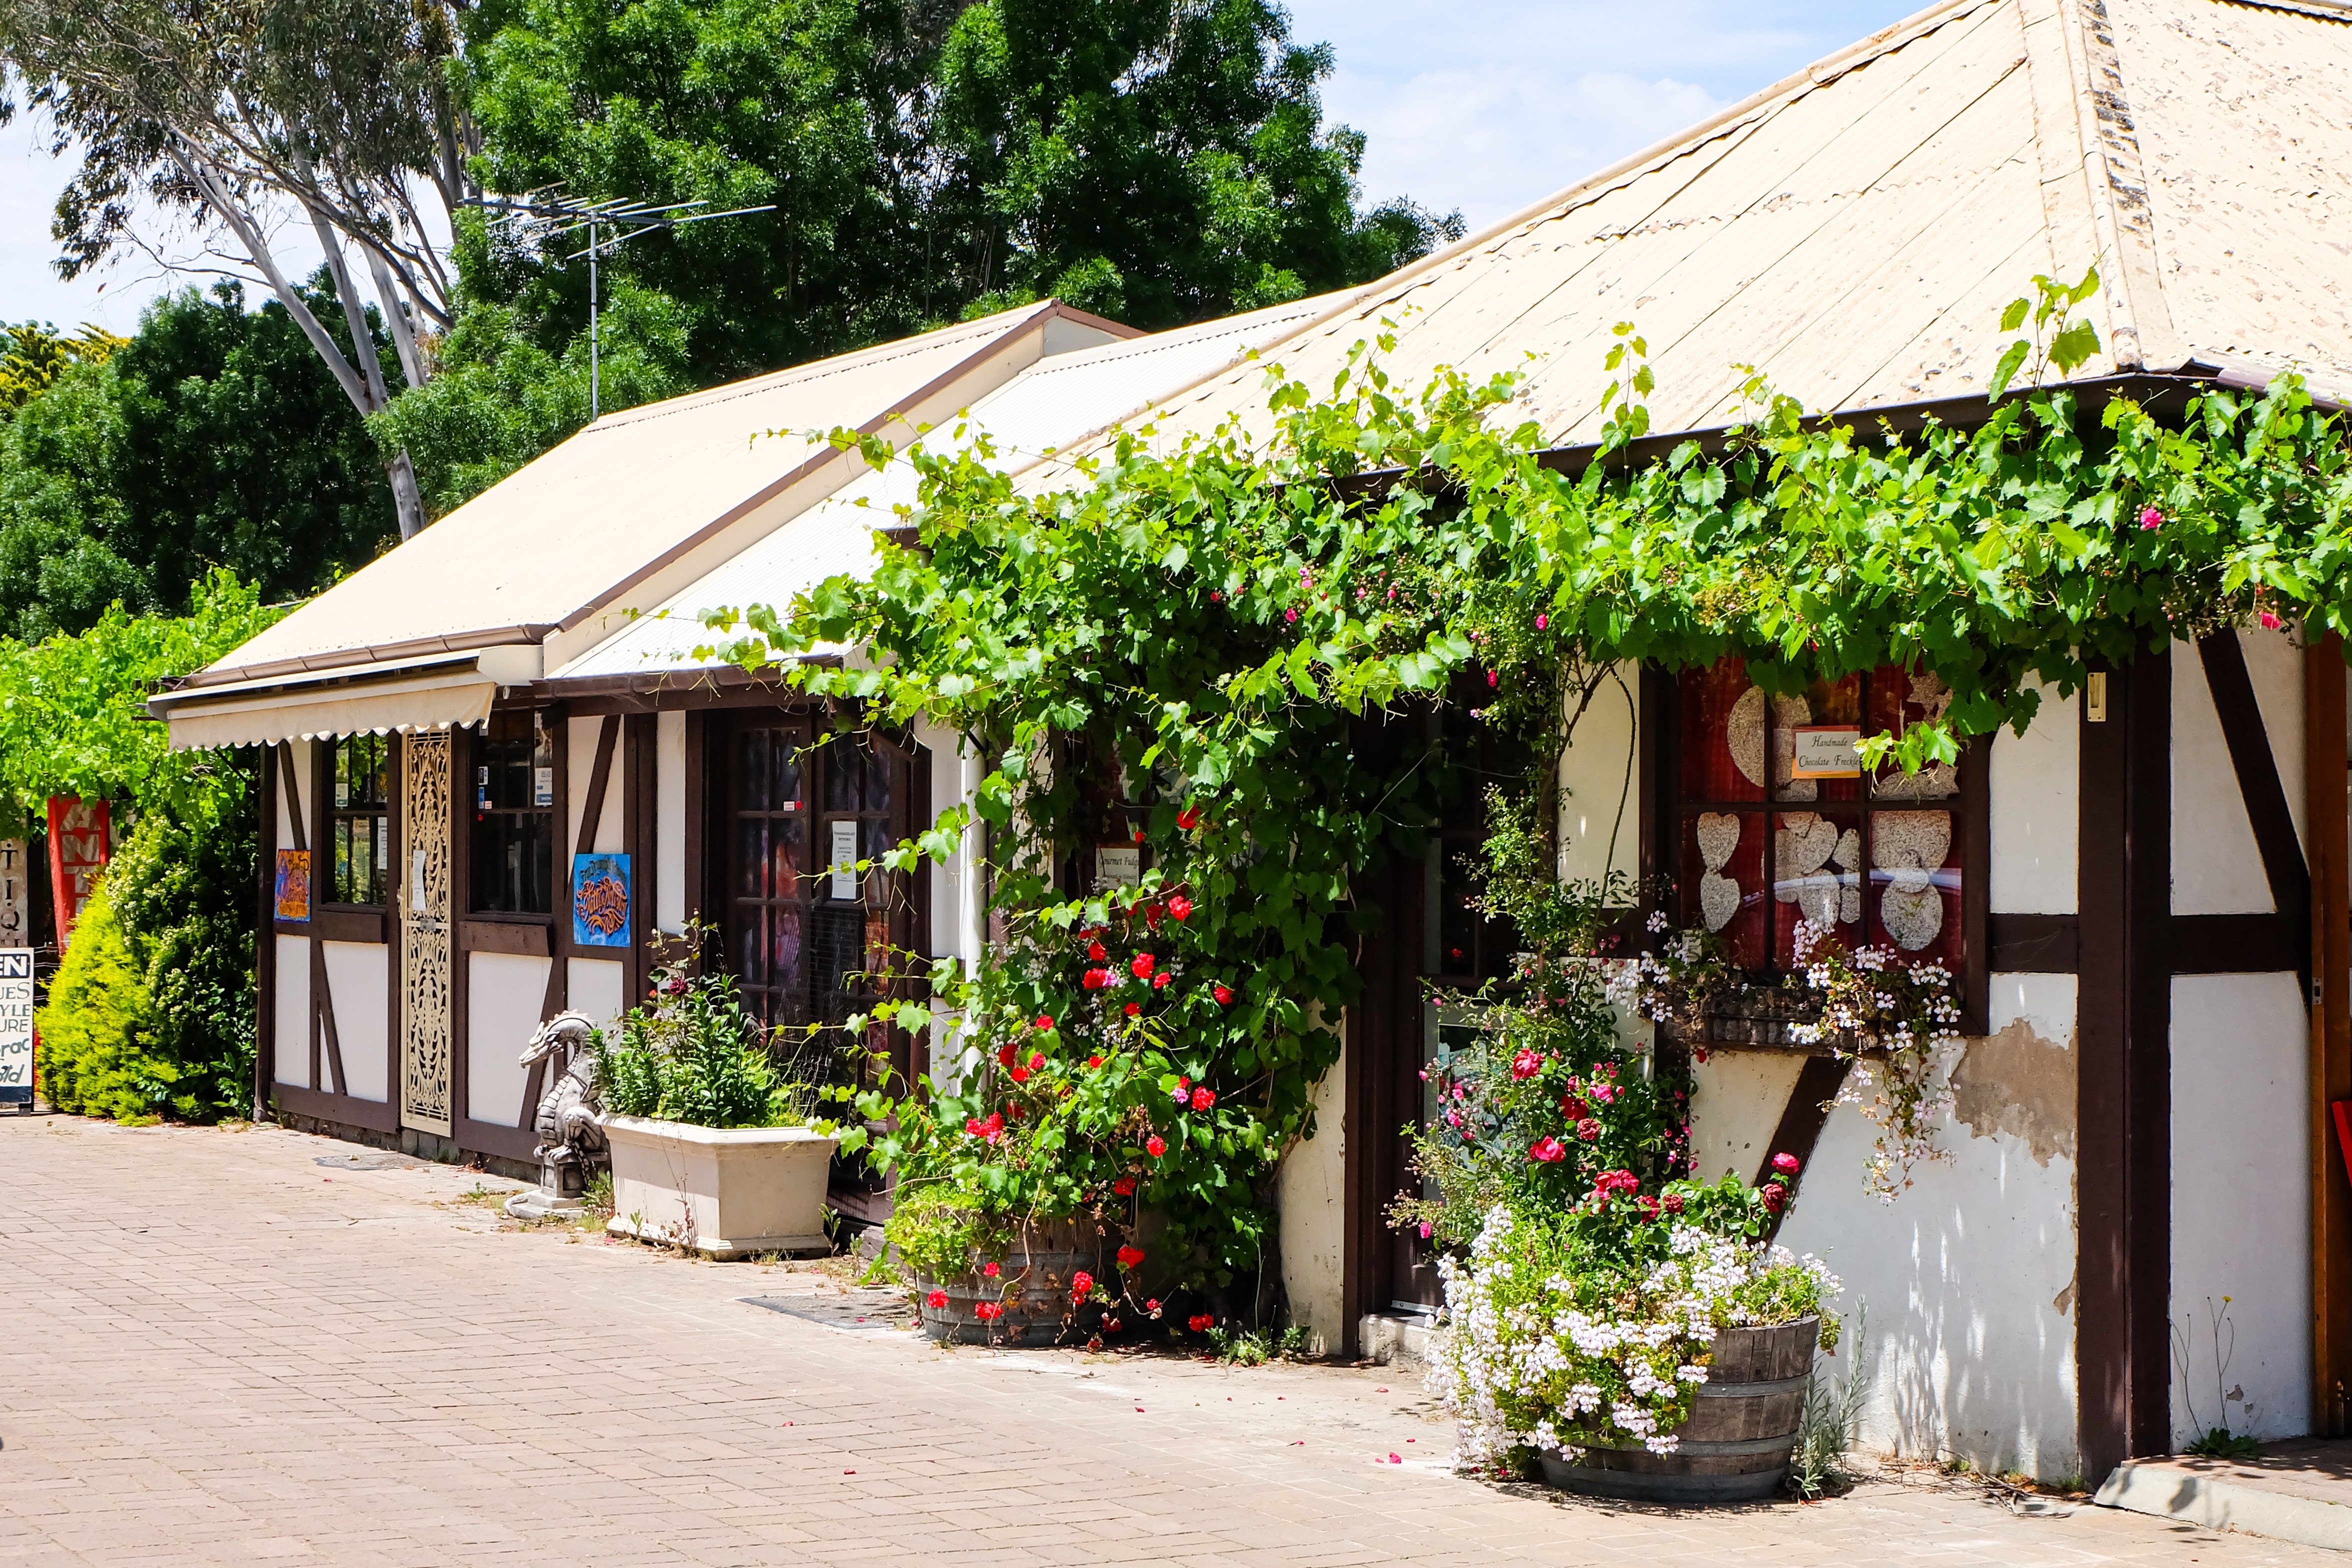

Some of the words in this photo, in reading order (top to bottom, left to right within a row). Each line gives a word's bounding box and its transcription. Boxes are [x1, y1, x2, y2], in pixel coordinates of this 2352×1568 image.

[1812, 735, 1848, 747] Handmade
[1799, 755, 1830, 767] Chocolate
[1834, 755, 1860, 768] Freckle
[0, 956, 27, 976] N
[0, 1038, 29, 1057] rac
